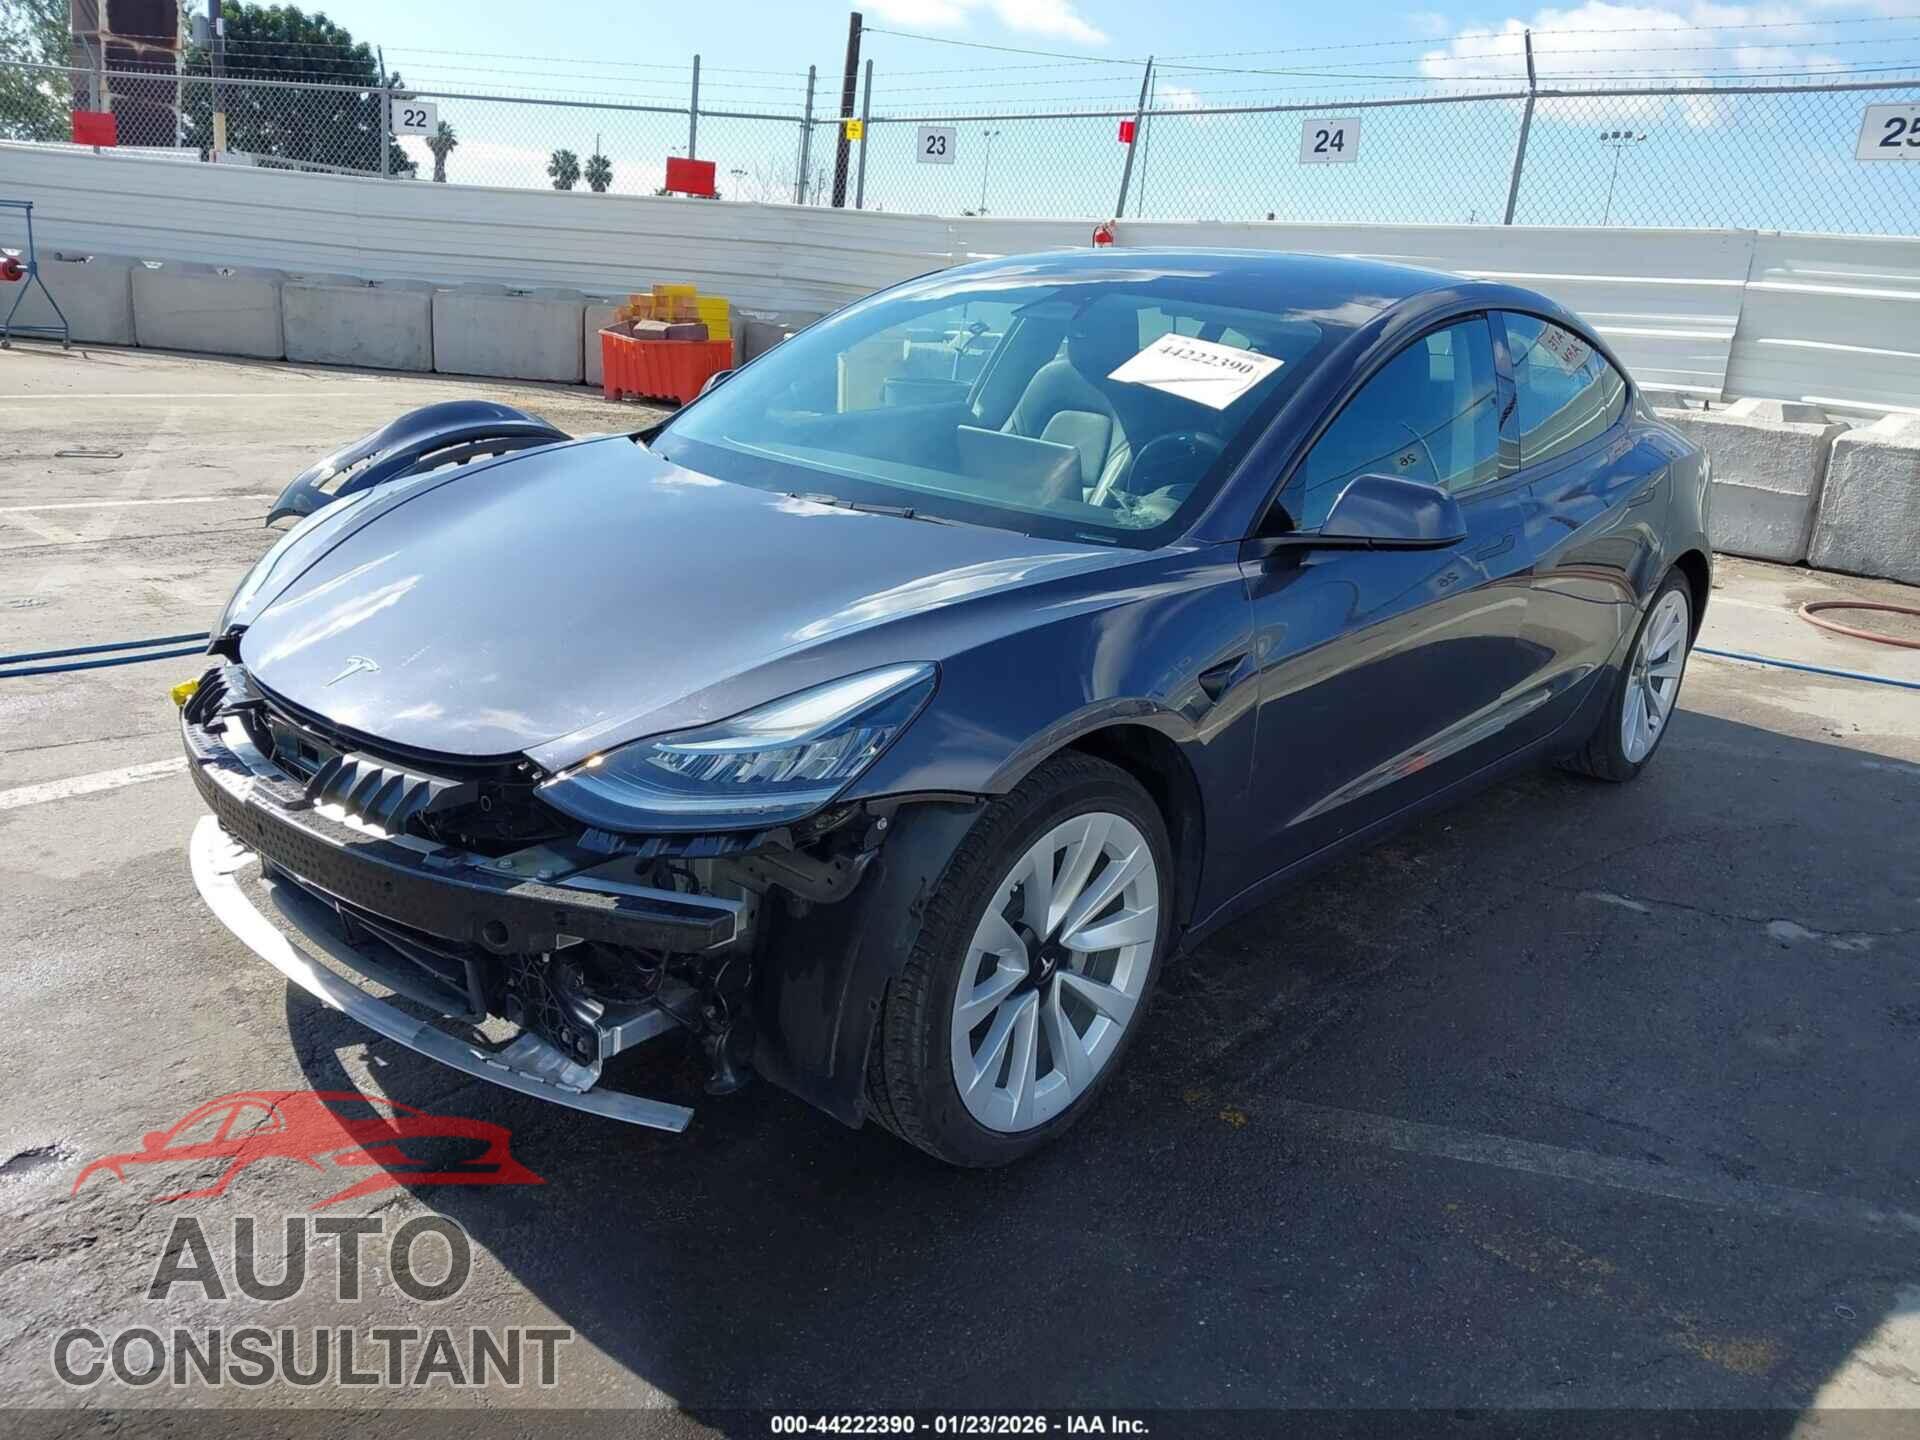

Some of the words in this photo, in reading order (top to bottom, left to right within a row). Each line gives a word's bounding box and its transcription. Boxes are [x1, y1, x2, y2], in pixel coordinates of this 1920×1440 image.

[403, 109, 427, 128] 22
[1314, 129, 1344, 153] 24
[1879, 117, 1920, 147] 25
[926, 135, 946, 156] 23
[1158, 345, 1254, 375] 44222390
